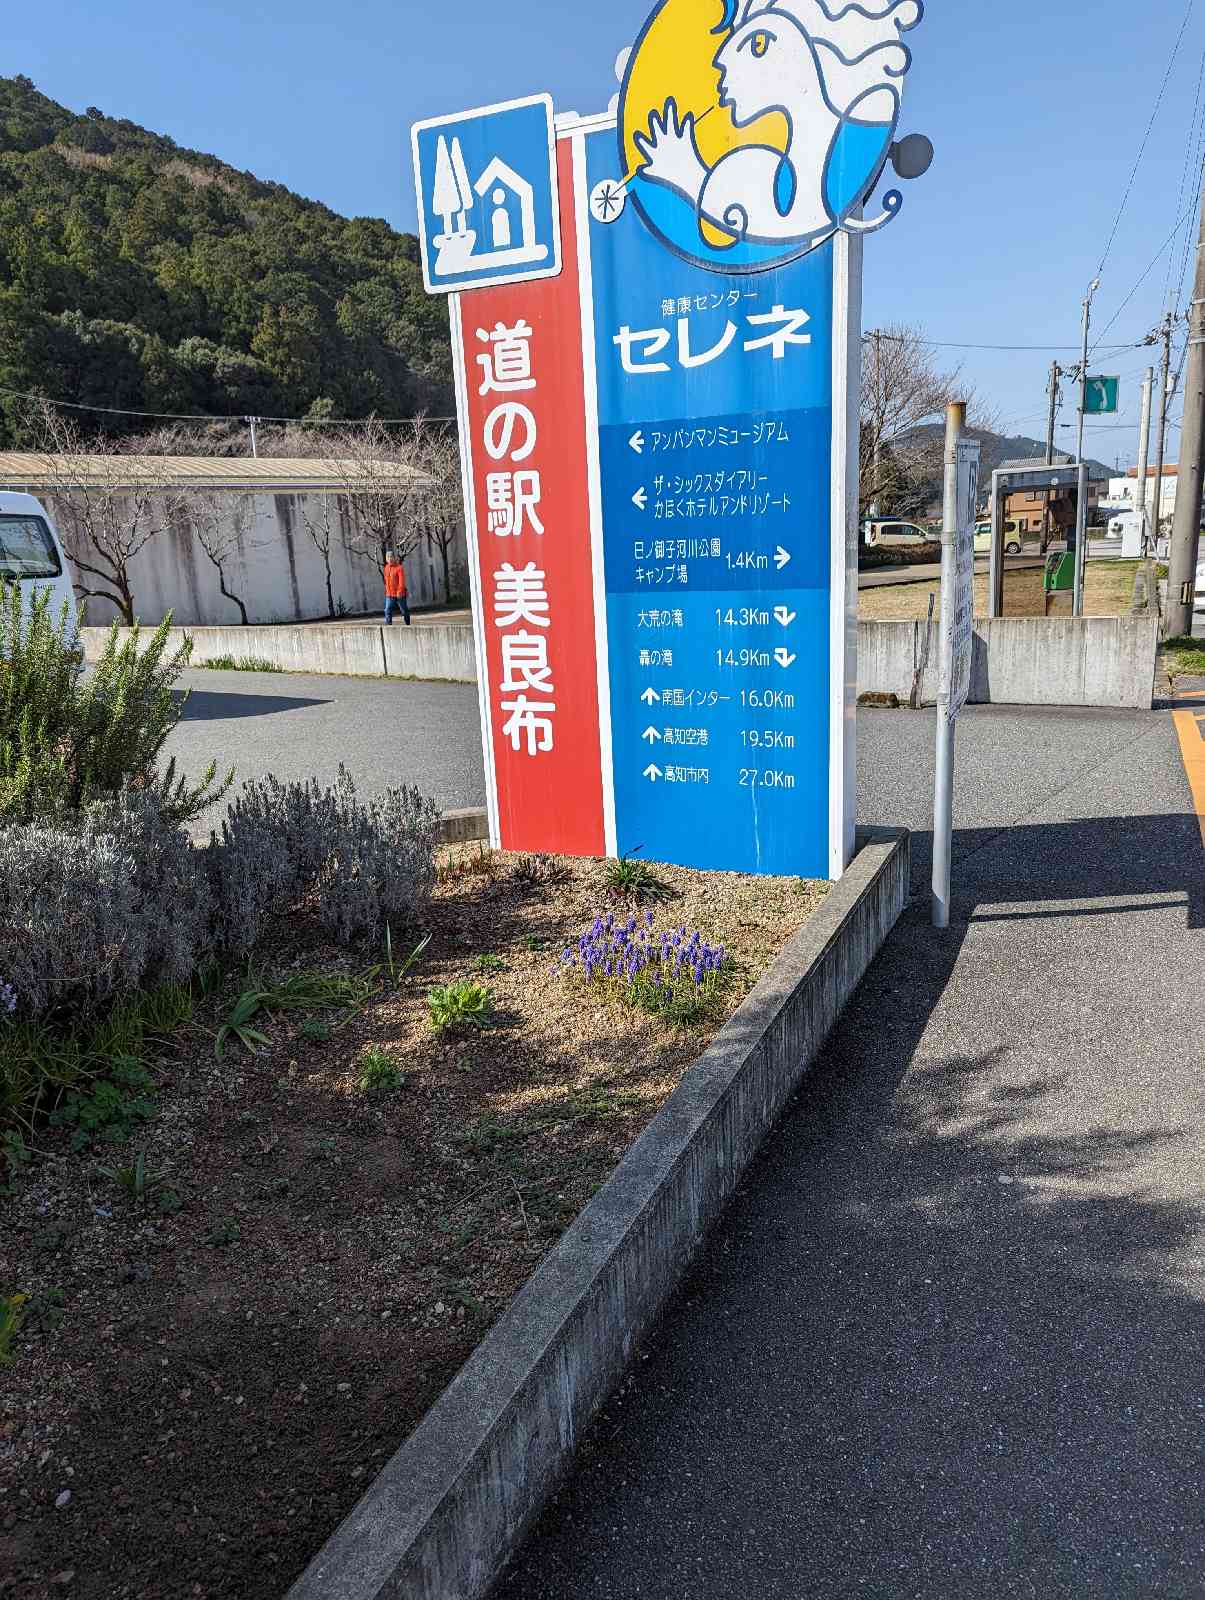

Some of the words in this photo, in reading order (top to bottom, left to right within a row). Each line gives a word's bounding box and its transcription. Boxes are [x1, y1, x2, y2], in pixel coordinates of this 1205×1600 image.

[661, 290, 758, 315] 健康センター
[612, 304, 812, 374] セレネ
[475, 319, 545, 536] 道の駅
[651, 421, 789, 452] アンパンマンミュージアム
[653, 470, 769, 496] ザ・シックスダイアリー
[654, 491, 791, 519] かほくホテルアンドリゾート
[634, 537, 721, 560] 日ノ御子河川公園
[725, 551, 768, 570] 1.4Km
[635, 564, 688, 585] キャンプ場
[638, 609, 684, 628] 大荒の滝
[715, 608, 769, 626] 14.3Km
[492, 562, 557, 757] 美良布
[716, 649, 770, 667] 14.9Km
[662, 688, 731, 706] 南国インター
[740, 690, 795, 708] 16.0Km
[663, 728, 709, 745] 高知空港
[740, 730, 795, 748] 19.5Km
[664, 766, 710, 784] 高知市内
[739, 768, 795, 788] 27.0Km
